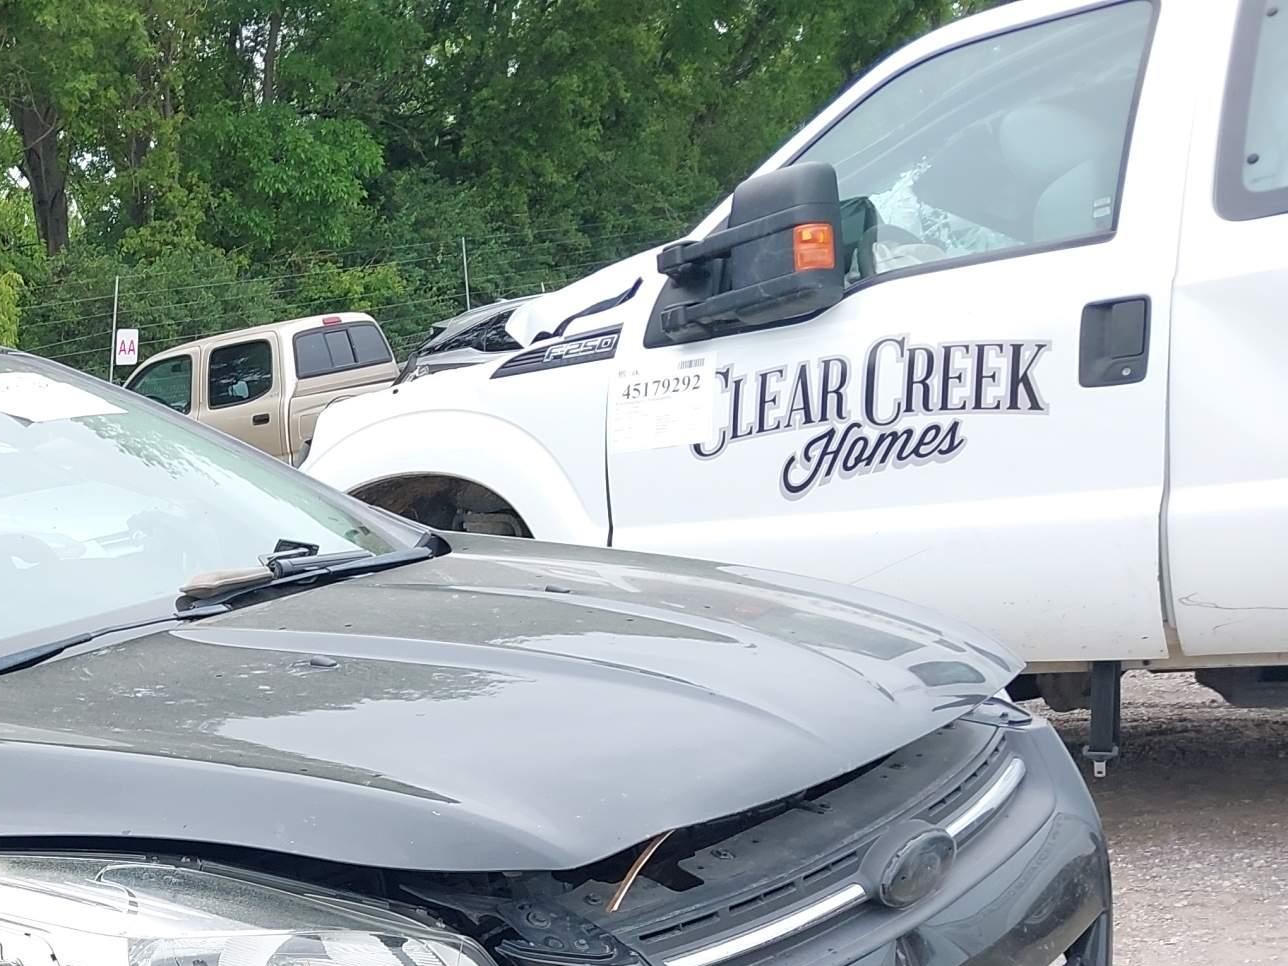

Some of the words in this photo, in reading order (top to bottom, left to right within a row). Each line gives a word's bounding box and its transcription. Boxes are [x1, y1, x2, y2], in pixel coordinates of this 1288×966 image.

[118, 339, 136, 355] AA
[622, 374, 701, 400] 45179292
[864, 336, 1048, 427] CREEK
[782, 420, 964, 494] Homes
